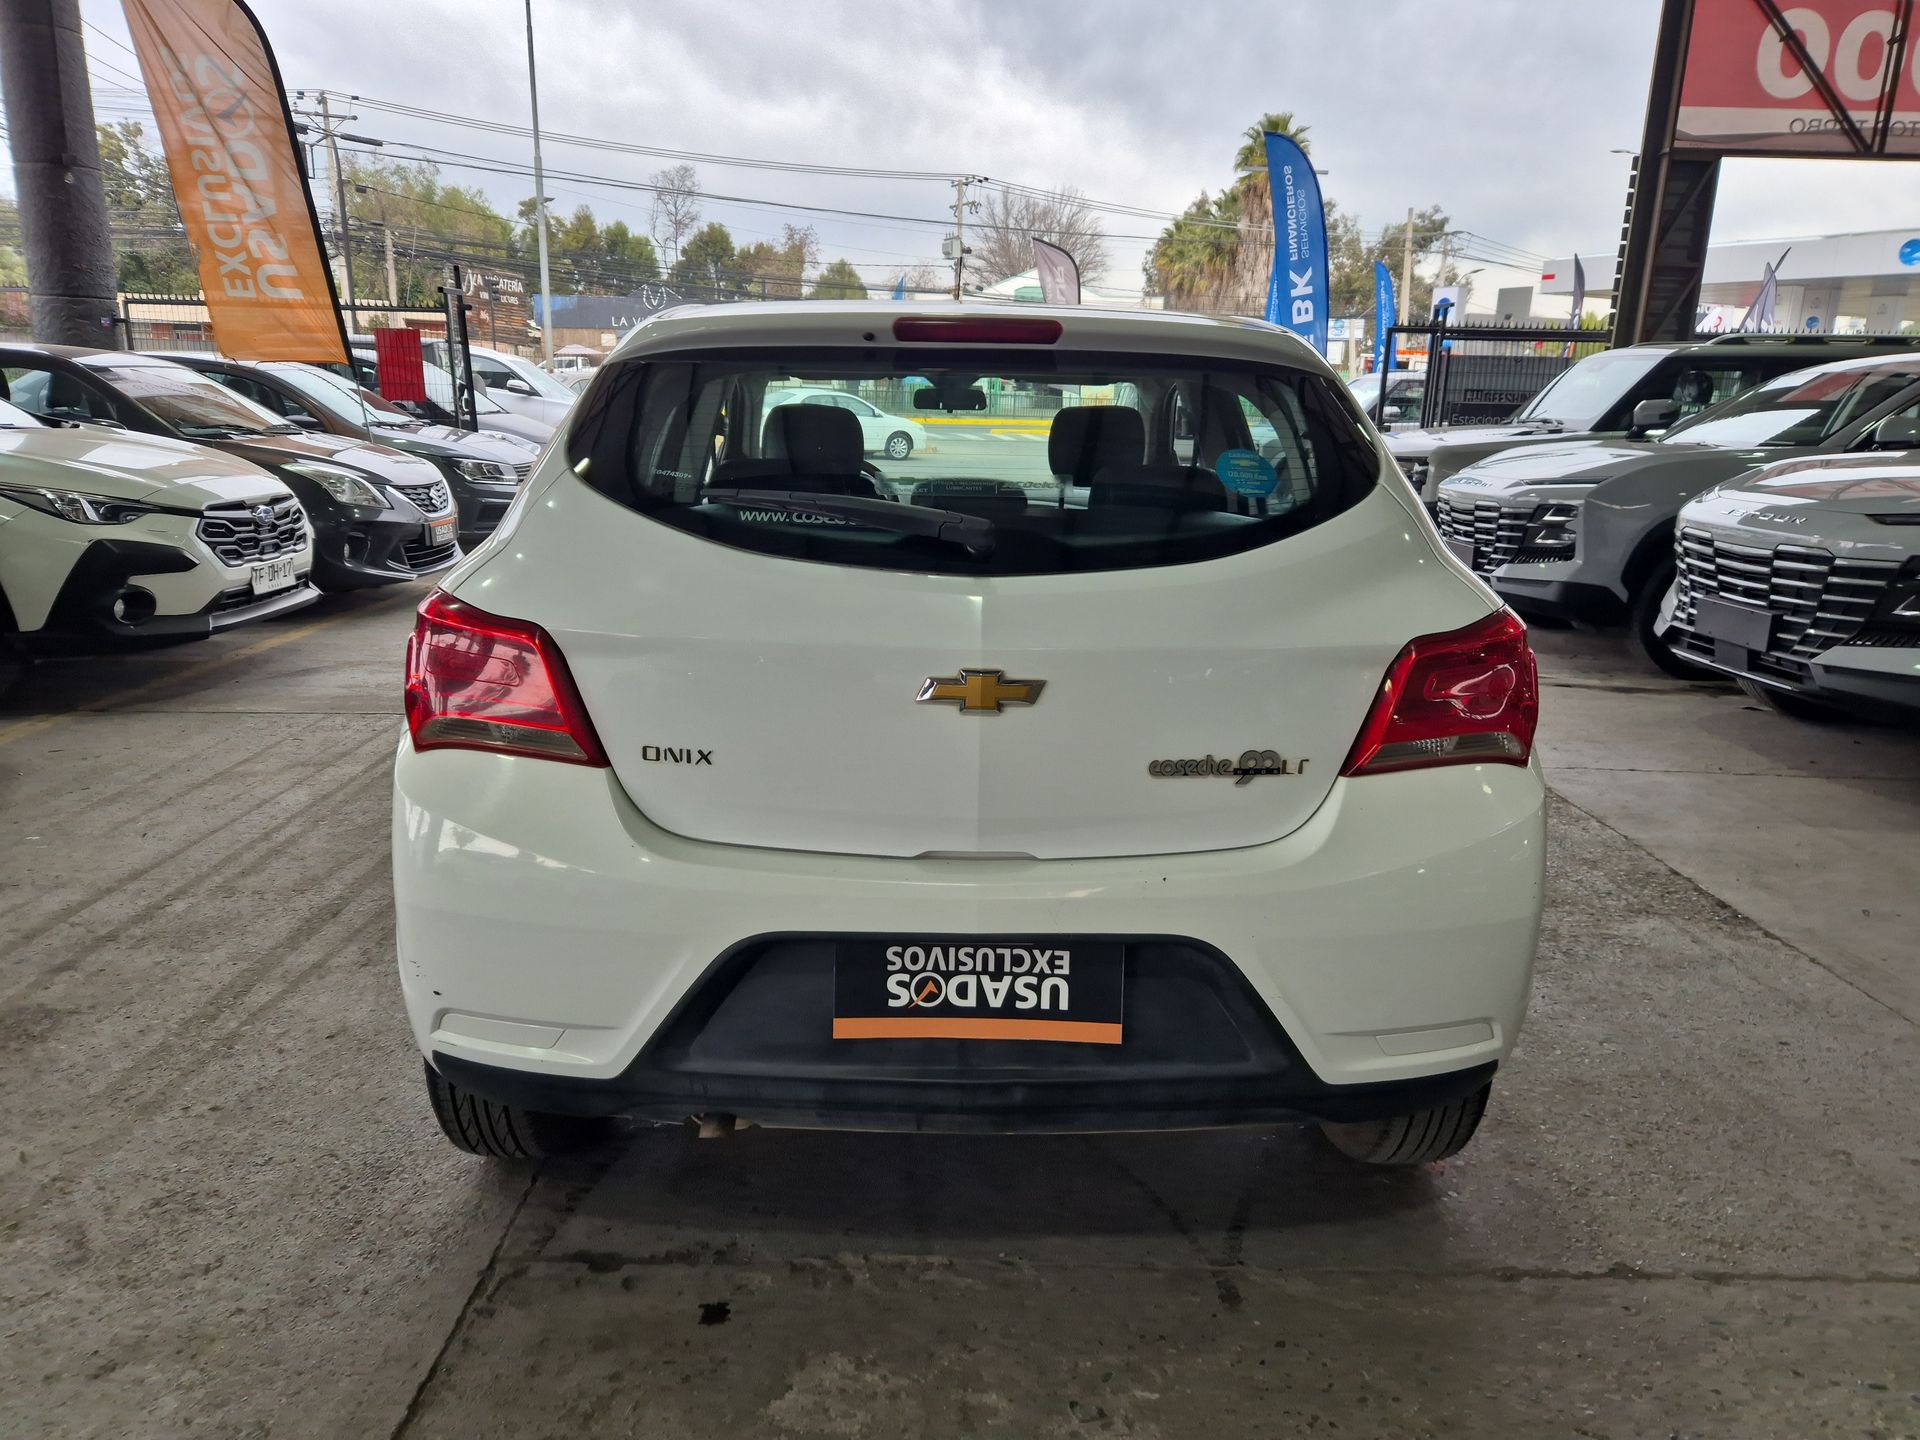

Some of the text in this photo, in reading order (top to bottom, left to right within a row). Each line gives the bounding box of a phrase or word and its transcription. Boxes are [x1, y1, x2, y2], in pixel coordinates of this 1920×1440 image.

[612, 316, 628, 327] LA
[1452, 413, 1509, 426] Estaciona
[642, 745, 713, 766] ONIX
[1281, 758, 1310, 775] LT
[886, 945, 1071, 975] EXCLUSIVOS
[886, 971, 1070, 1011] USADOS
